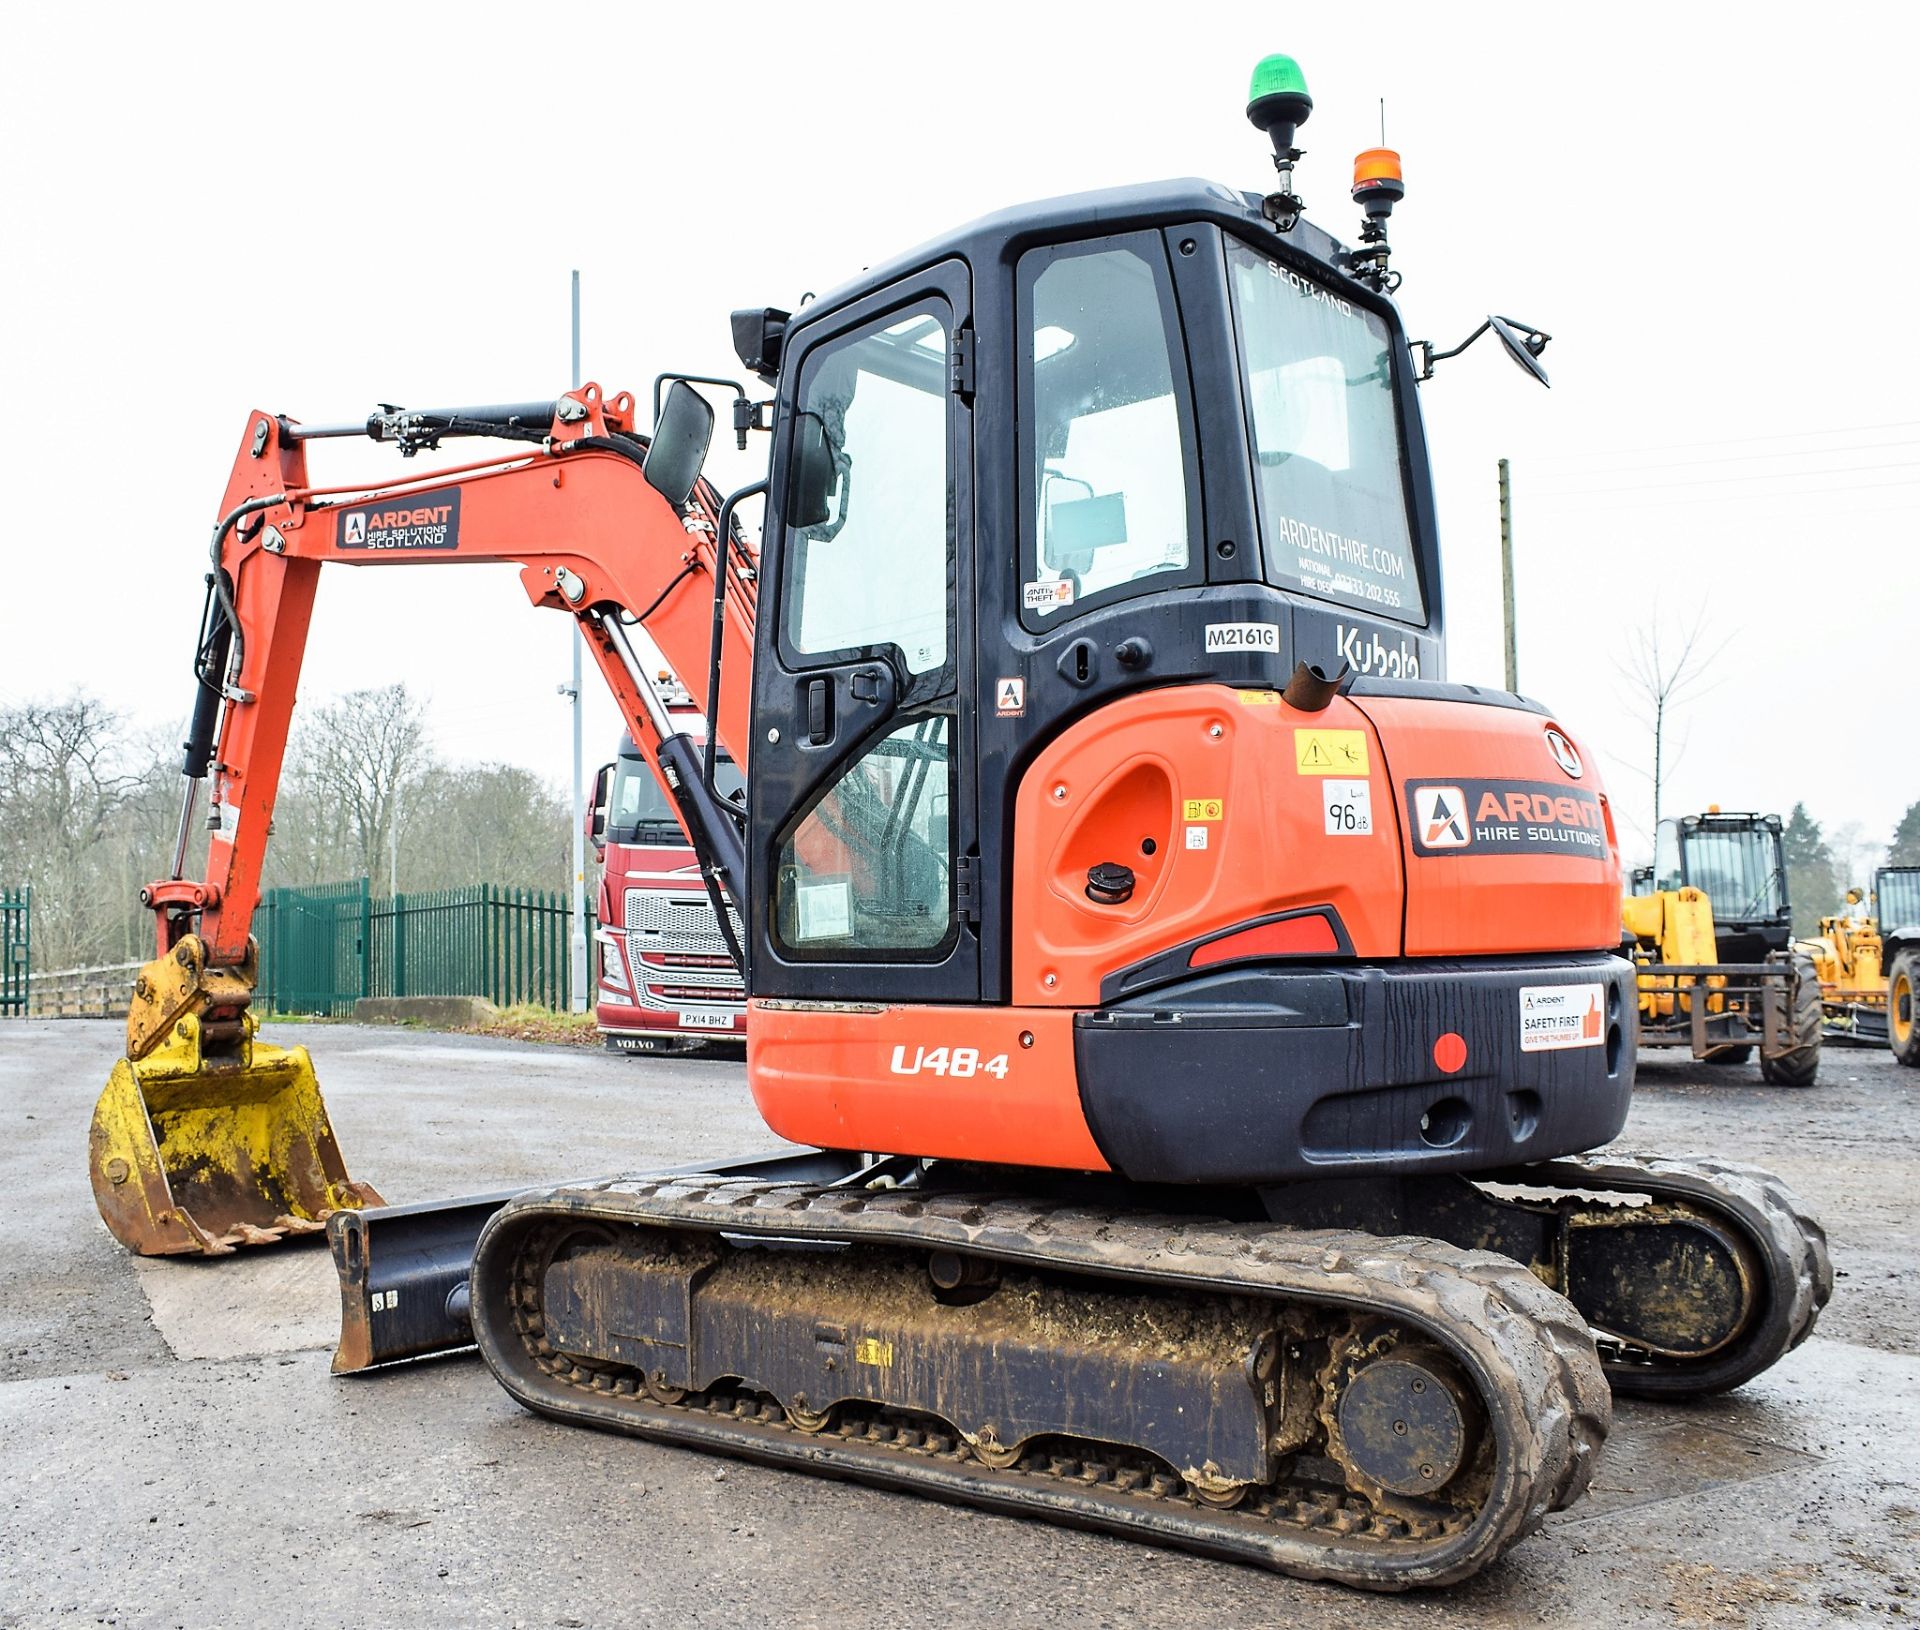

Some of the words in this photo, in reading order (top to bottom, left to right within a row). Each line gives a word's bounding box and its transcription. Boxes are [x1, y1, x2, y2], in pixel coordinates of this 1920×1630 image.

[1268, 260, 1352, 318] SCOTLAND
[368, 506, 452, 530] ARDENT
[367, 530, 388, 540] HIRE
[392, 525, 448, 538] SOLUTIONS
[367, 534, 444, 549] SCOTLAND
[1280, 516, 1405, 580] ARDENTHIRE.COM
[1298, 557, 1333, 578] NATIONAL
[1300, 576, 1316, 590] HIRE
[1316, 579, 1335, 595] DESK
[1365, 582, 1383, 603] 202
[1384, 588, 1400, 608] 555
[1208, 629, 1274, 646] M2161G
[1336, 624, 1420, 680] Kubota
[1330, 804, 1356, 830] 96
[1475, 792, 1600, 830] ARDENT
[1476, 828, 1520, 841] HIRE
[1527, 828, 1601, 848] SOLUTIONS
[685, 1014, 706, 1024] PX14
[708, 1016, 727, 1026] BHZ
[1524, 1017, 1558, 1030] SAFETY
[1560, 1016, 1580, 1028] FIRST
[616, 1040, 654, 1049] VOLVO
